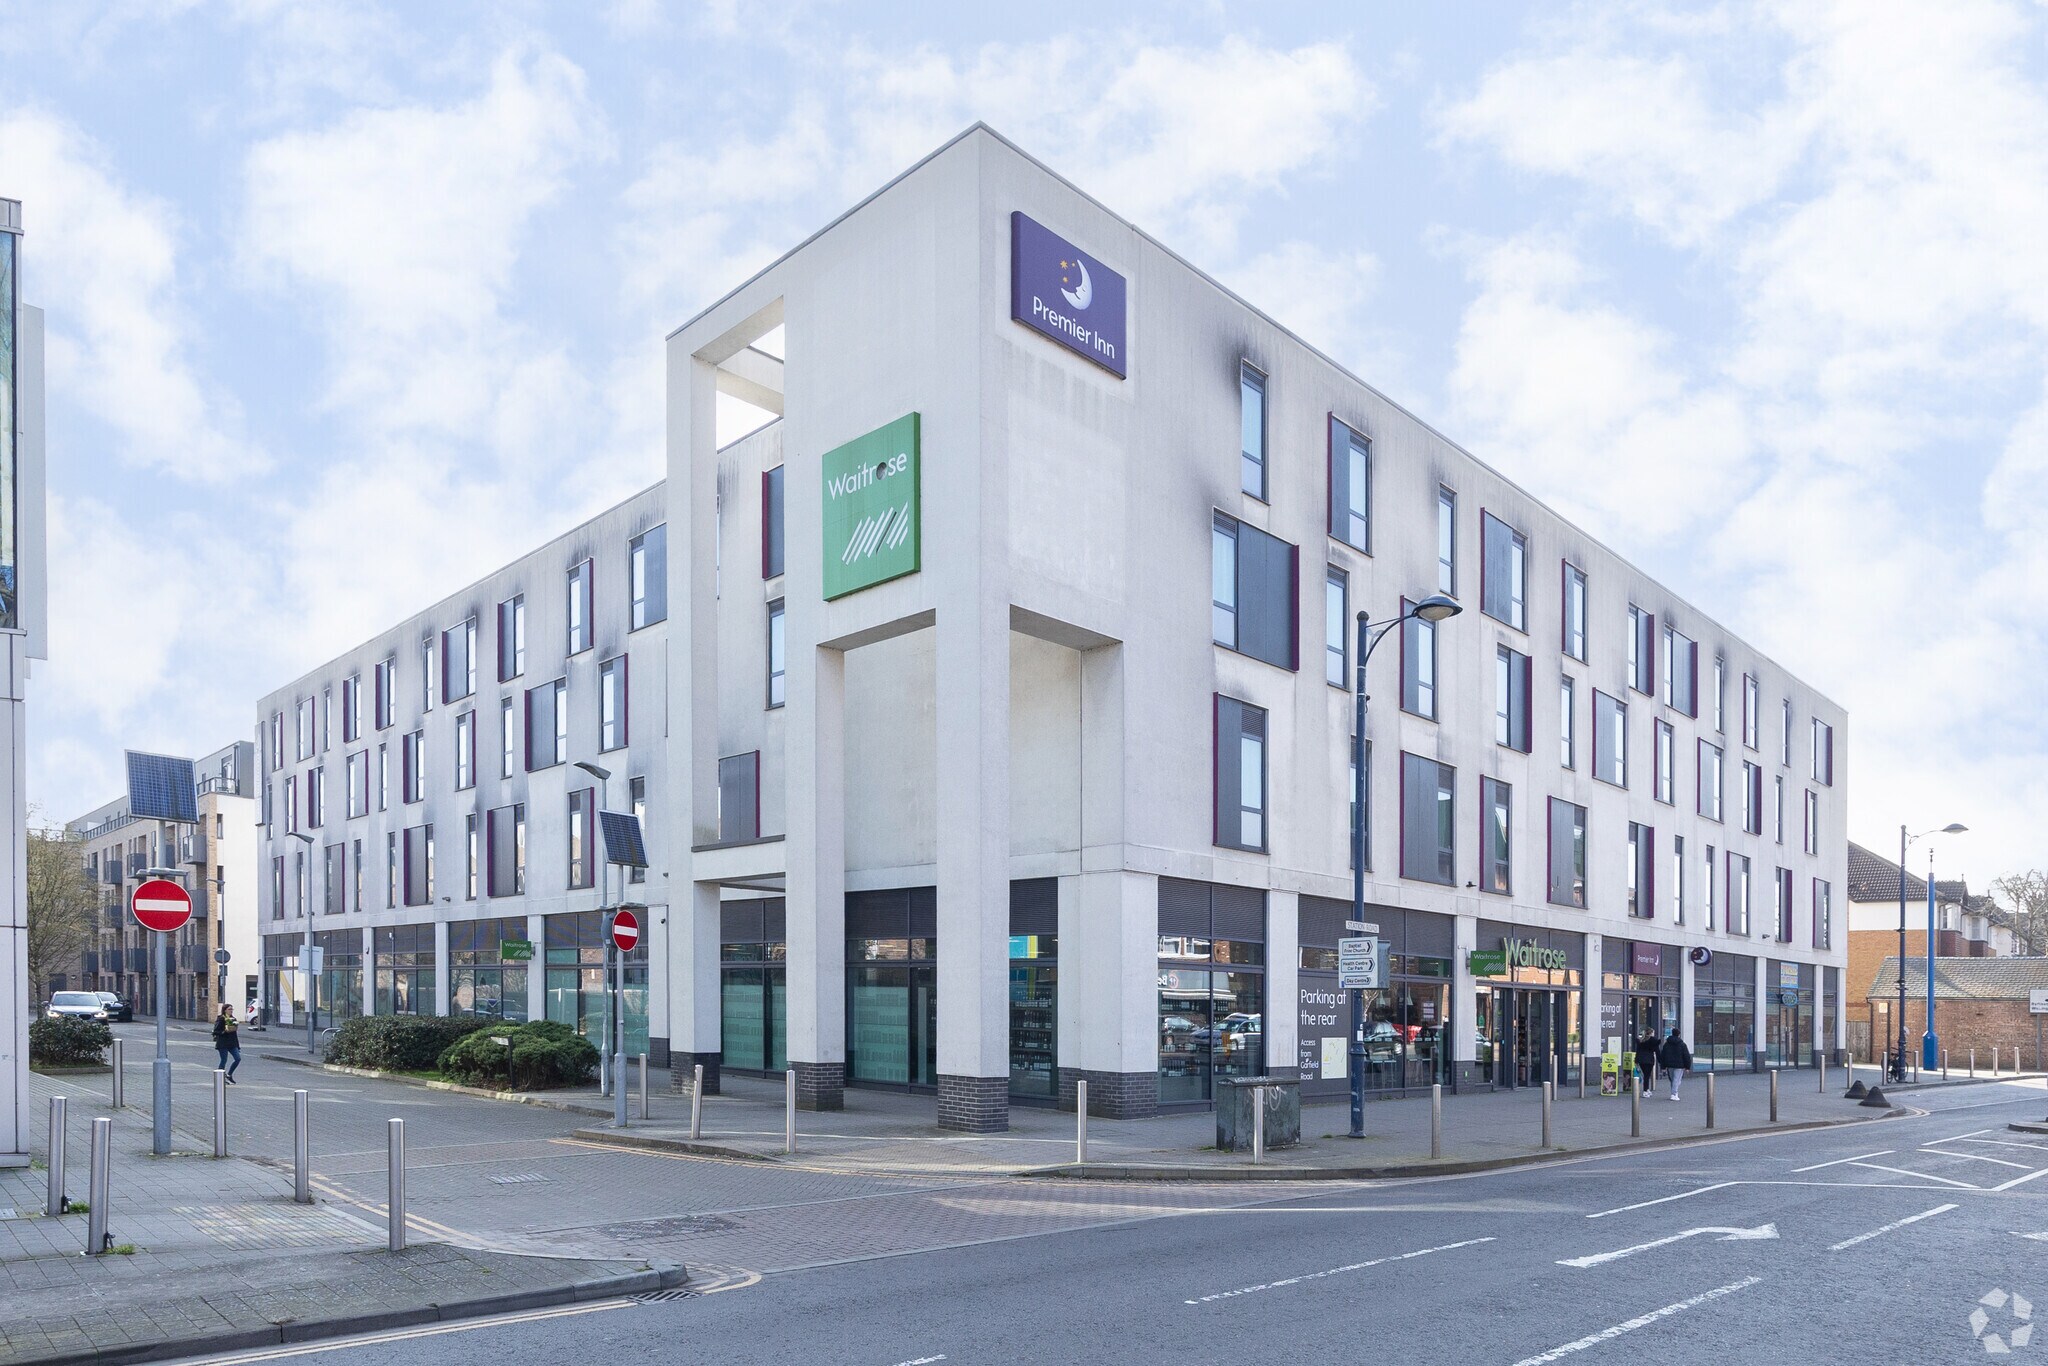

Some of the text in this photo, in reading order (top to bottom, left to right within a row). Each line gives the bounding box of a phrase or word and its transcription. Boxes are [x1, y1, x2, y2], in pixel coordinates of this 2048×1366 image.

[1033, 295, 1115, 359] Premier Inn
[1347, 921, 1365, 930] STATION
[1504, 937, 1567, 969] Waitrose
[1301, 988, 1346, 1009] Parking at
[1600, 1002, 1615, 1017] arking
[1301, 1010, 1337, 1025] the rear
[1301, 1049, 1312, 1057] from
[1301, 1060, 1319, 1069] Garfield
[1301, 1072, 1313, 1080] Road
